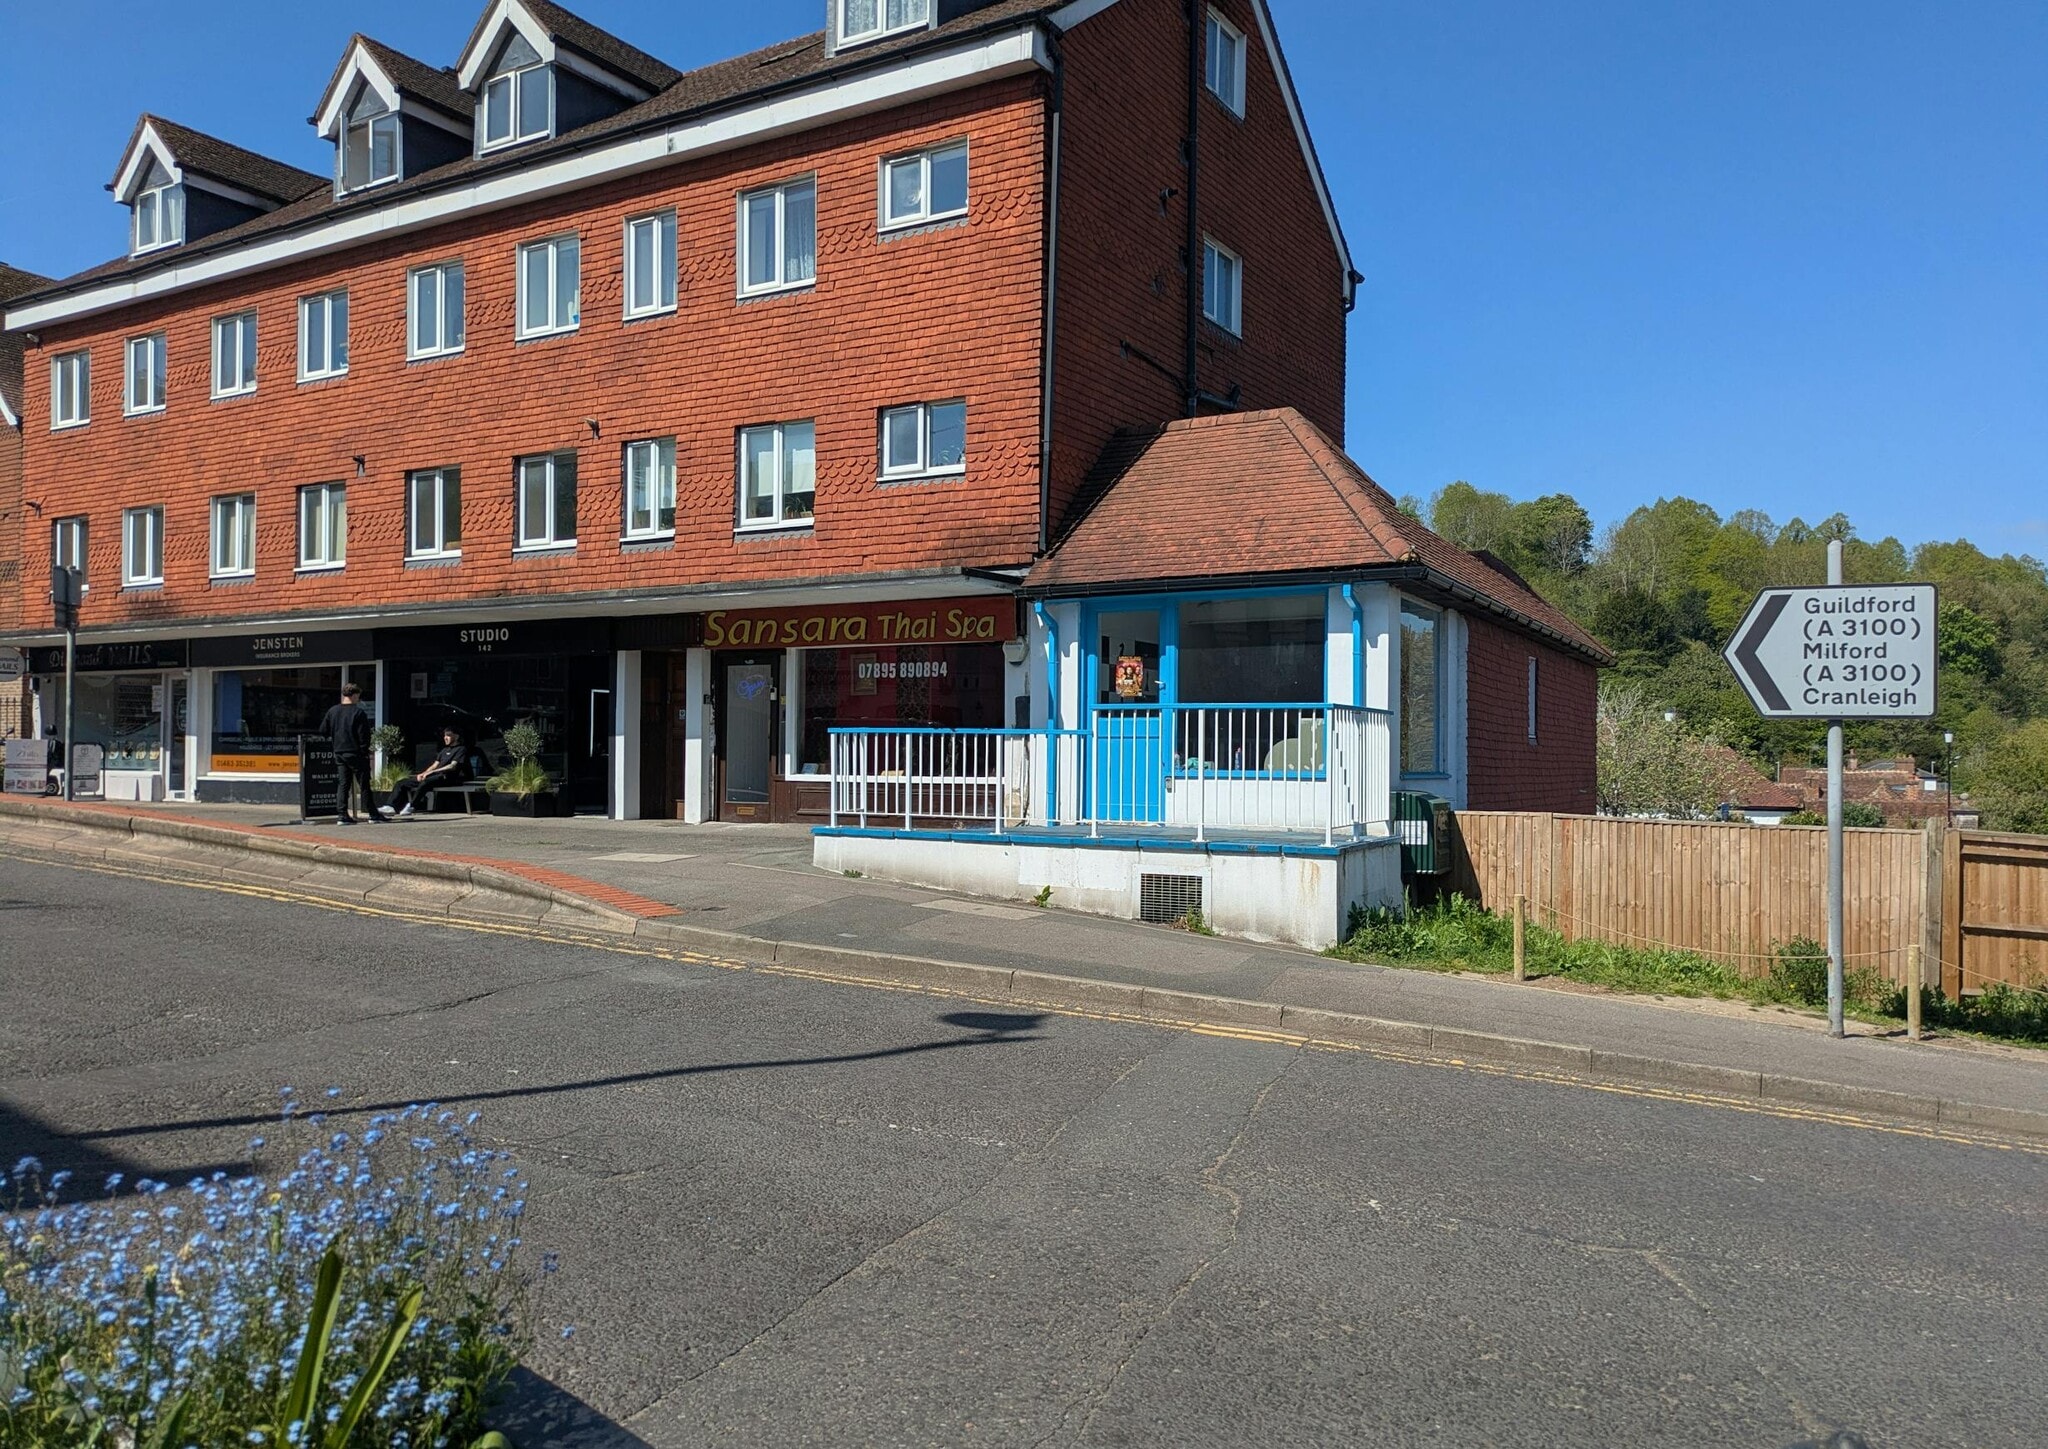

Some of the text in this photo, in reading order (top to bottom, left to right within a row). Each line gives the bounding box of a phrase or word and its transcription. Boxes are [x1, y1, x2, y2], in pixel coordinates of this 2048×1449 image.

[1804, 595, 1915, 614] Guildford
[460, 628, 509, 642] STUDIO
[703, 608, 996, 647] Sansara Thai Spa
[252, 637, 303, 650] JENSTEN
[1803, 642, 1887, 659] Milford
[858, 661, 948, 679] 07895 890894
[1803, 688, 1917, 708] Cranleigh
